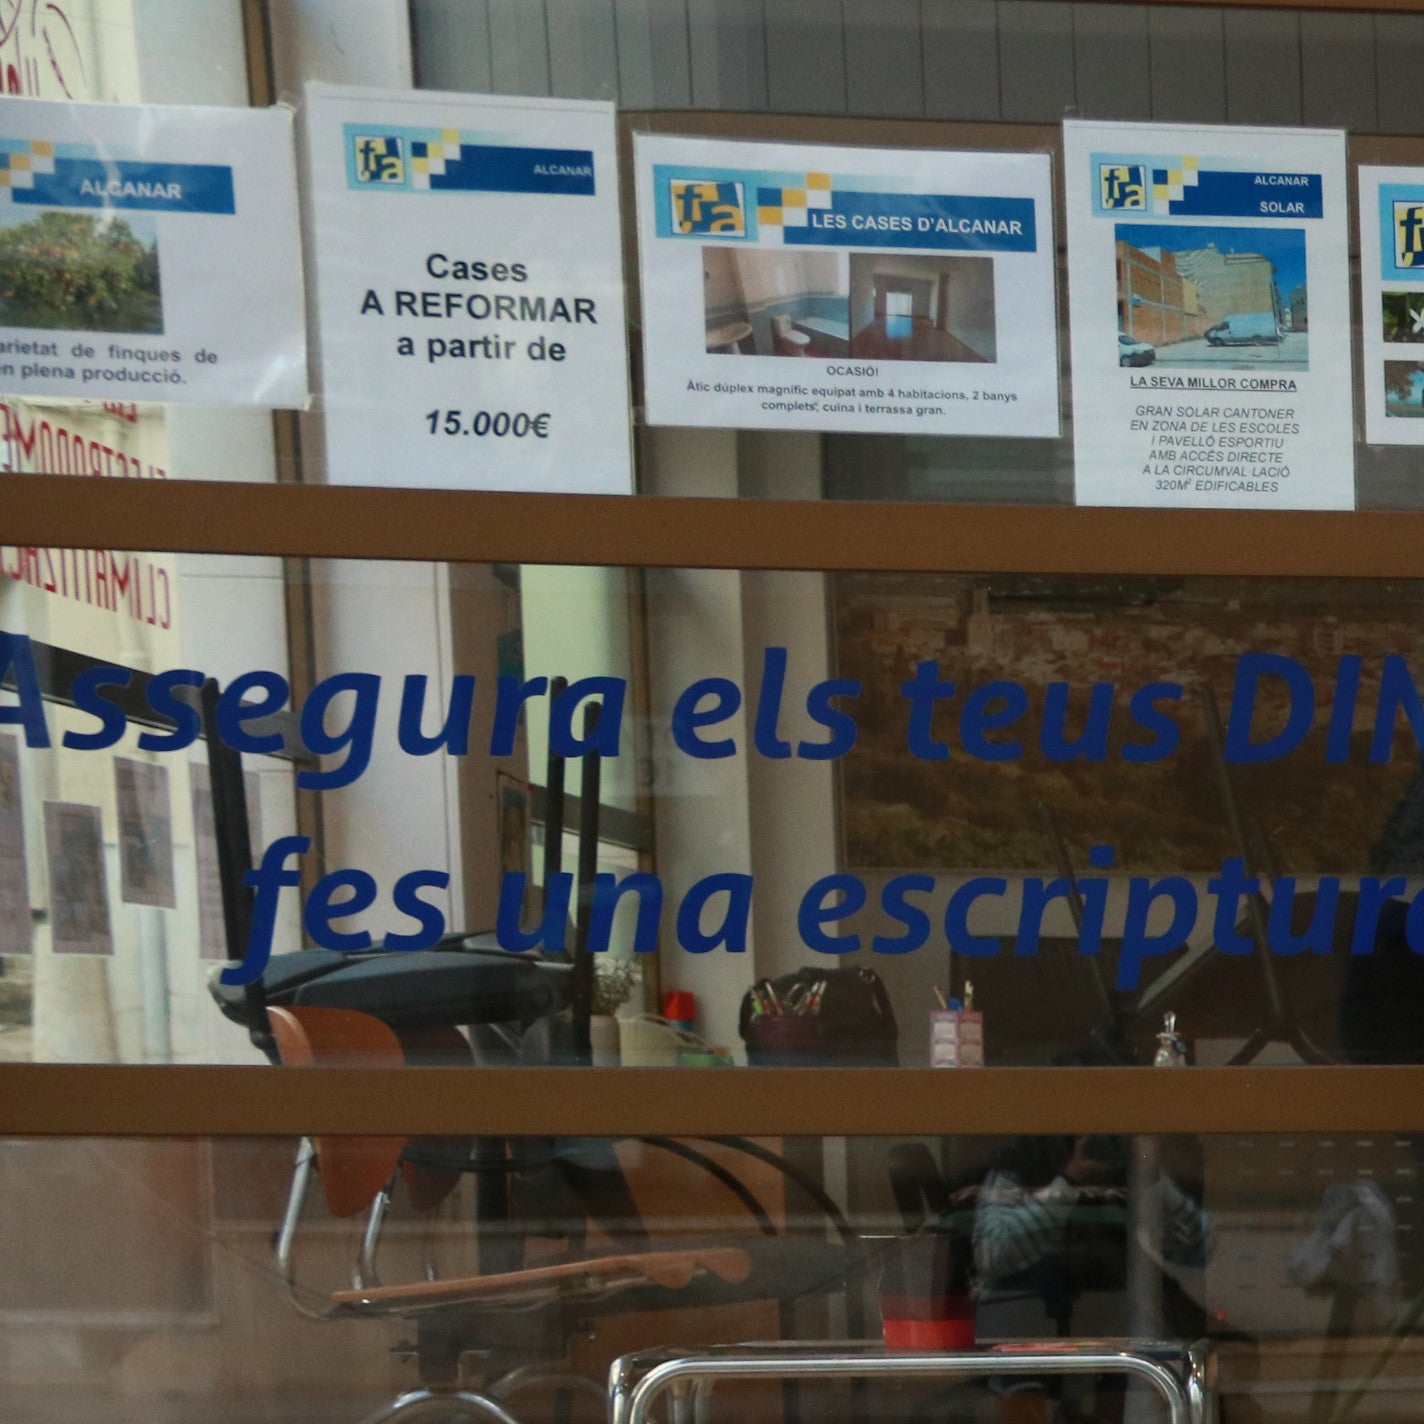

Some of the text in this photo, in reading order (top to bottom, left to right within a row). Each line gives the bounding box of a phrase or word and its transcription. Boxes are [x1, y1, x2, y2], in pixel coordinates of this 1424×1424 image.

[533, 163, 592, 178] ALCANAR
[80, 178, 182, 199] ALCANAR
[1254, 175, 1309, 187] ALCANAR
[1259, 201, 1305, 214] SOLAR
[812, 212, 847, 230] LES
[852, 213, 912, 232] CASES
[426, 254, 528, 282] Cases
[361, 291, 597, 323] A REFORMAR
[71, 344, 95, 358] de
[109, 344, 181, 362] finques
[195, 350, 218, 364] de
[397, 337, 566, 364] a partir de
[22, 363, 75, 379] plena
[82, 367, 187, 384] producció.
[1130, 376, 1298, 391] LA SEVA MILLOR COMPRA
[812, 387, 856, 399] equipat
[859, 388, 885, 398] amb
[898, 388, 970, 401] habitacions,
[982, 391, 1018, 403] banys
[823, 403, 855, 413] cuina
[866, 405, 913, 416] terrassa
[916, 408, 947, 418] gran.
[1135, 405, 1295, 420] GRAN SOLAR CANTONER
[426, 410, 551, 438] 15.000€
[1130, 420, 1300, 435] EN ZONA DE LES ESCOLES
[1158, 436, 1215, 447] PAVELLÓ
[1218, 437, 1284, 449] ESPORTIU
[1149, 451, 1177, 461] AMB
[1227, 453, 1284, 464] DIRECTE
[1154, 465, 1170, 475] LA
[1195, 481, 1279, 493] EDIFICABLES
[0, 632, 627, 791] Assegura
[672, 647, 863, 761] els
[901, 660, 1184, 765] teus
[219, 836, 450, 986] fes
[494, 873, 754, 955] una
